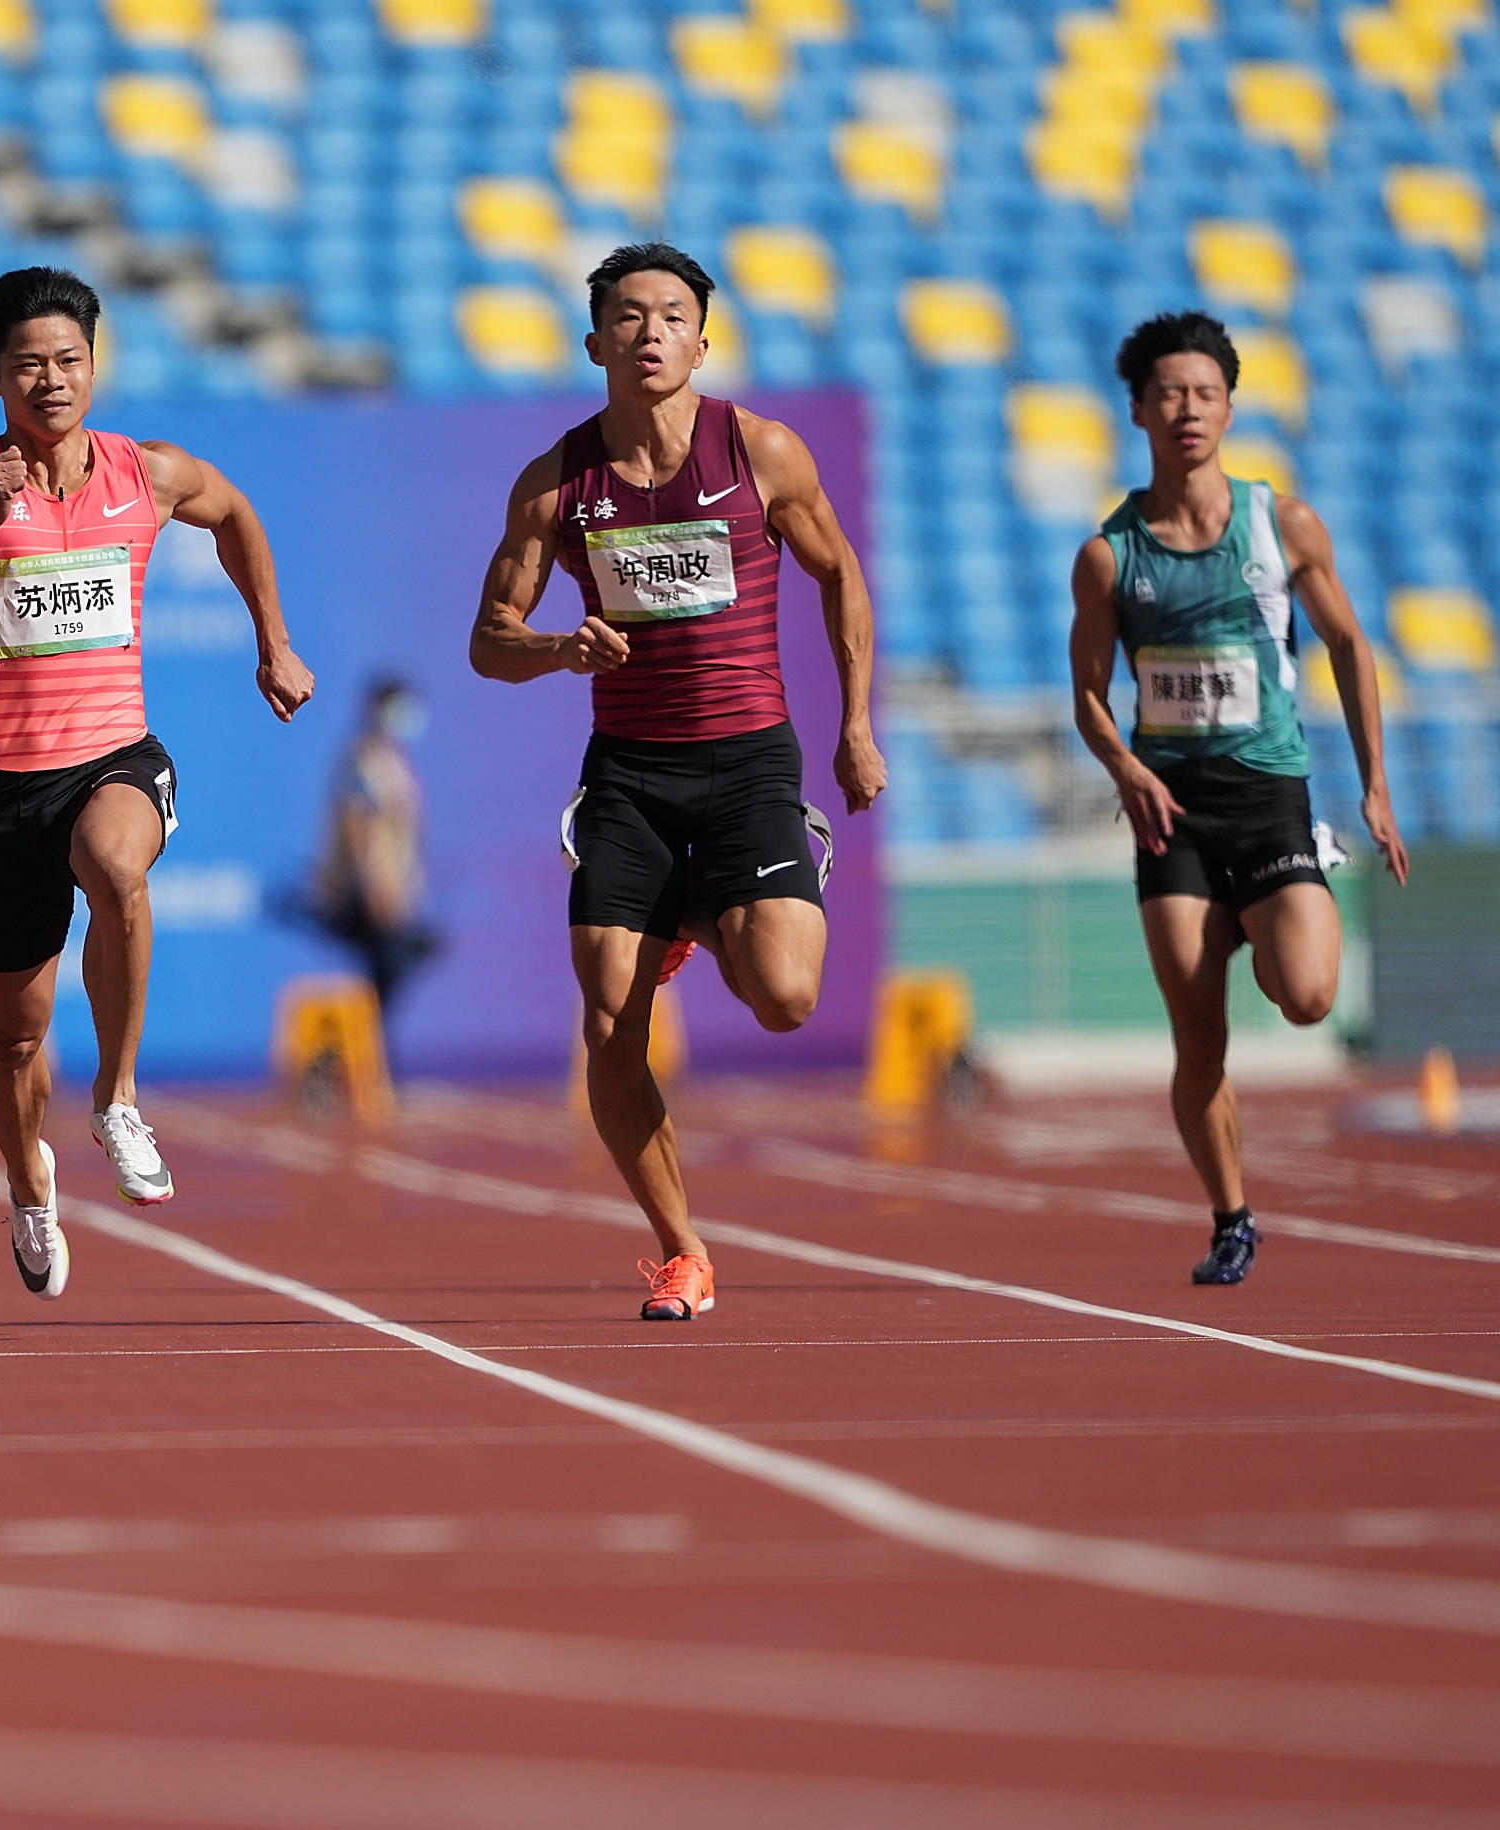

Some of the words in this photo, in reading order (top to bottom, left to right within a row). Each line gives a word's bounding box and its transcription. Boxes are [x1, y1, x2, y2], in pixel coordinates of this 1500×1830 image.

[571, 498, 617, 519] 上海
[612, 550, 711, 588] 许周政
[14, 578, 114, 619] 苏炳添
[651, 591, 680, 603] 1278
[54, 622, 84, 635] 1759
